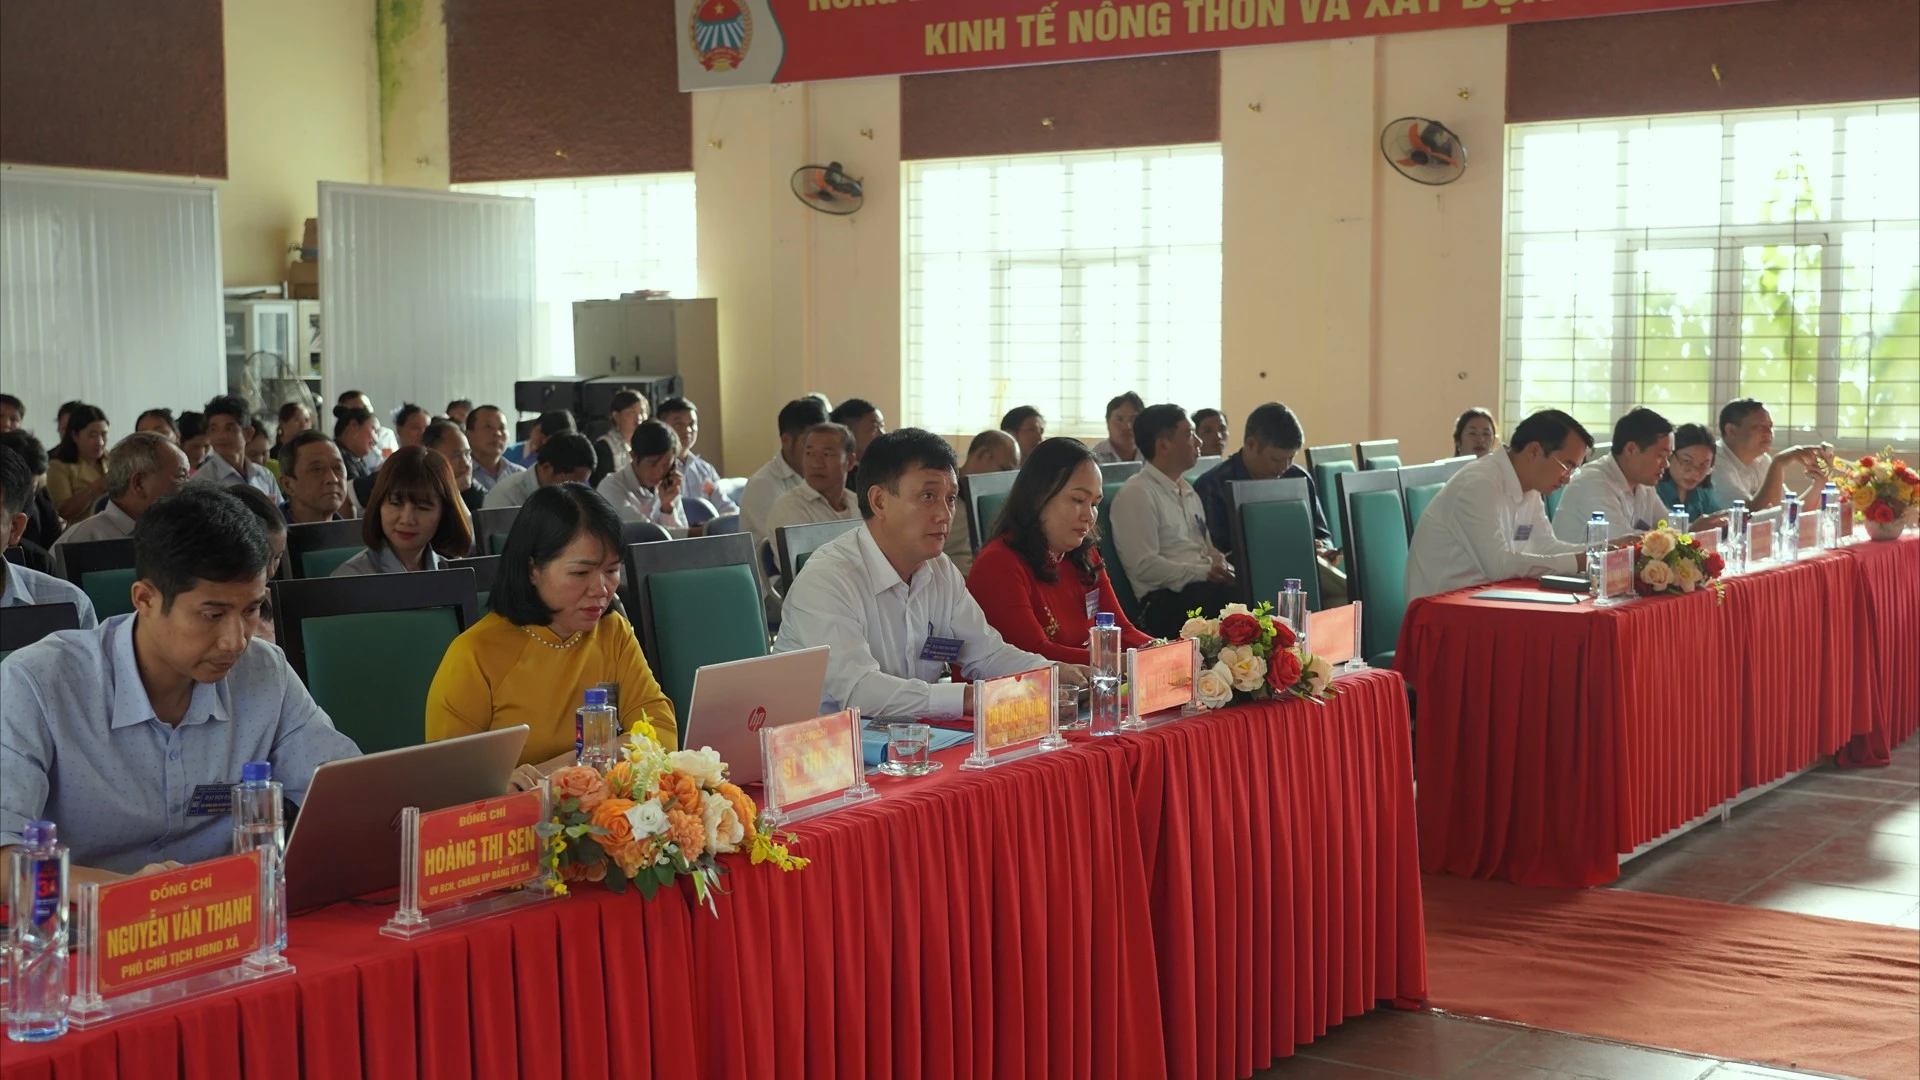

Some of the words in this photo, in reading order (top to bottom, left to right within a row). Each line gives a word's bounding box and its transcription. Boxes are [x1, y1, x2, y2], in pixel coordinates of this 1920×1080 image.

[924, 17, 1006, 56] KINH
[1015, 1, 1059, 48] TẾ
[1068, 0, 1171, 44] NÔNG
[748, 707, 766, 732] hp
[489, 805, 506, 820] CHÍ
[424, 839, 476, 877] HOÀNG
[480, 832, 504, 865] THỊ
[507, 825, 536, 857] SEN
[150, 881, 188, 901] ĐỒNG
[190, 873, 212, 891] CHÍ
[106, 908, 169, 959] NGUYỄN
[172, 904, 202, 941] VĂN
[206, 895, 252, 933] THANH
[121, 958, 143, 979] PHÓ
[145, 951, 168, 972] CHỦ
[170, 947, 193, 967] TỊCH
[195, 940, 223, 958] UBND
